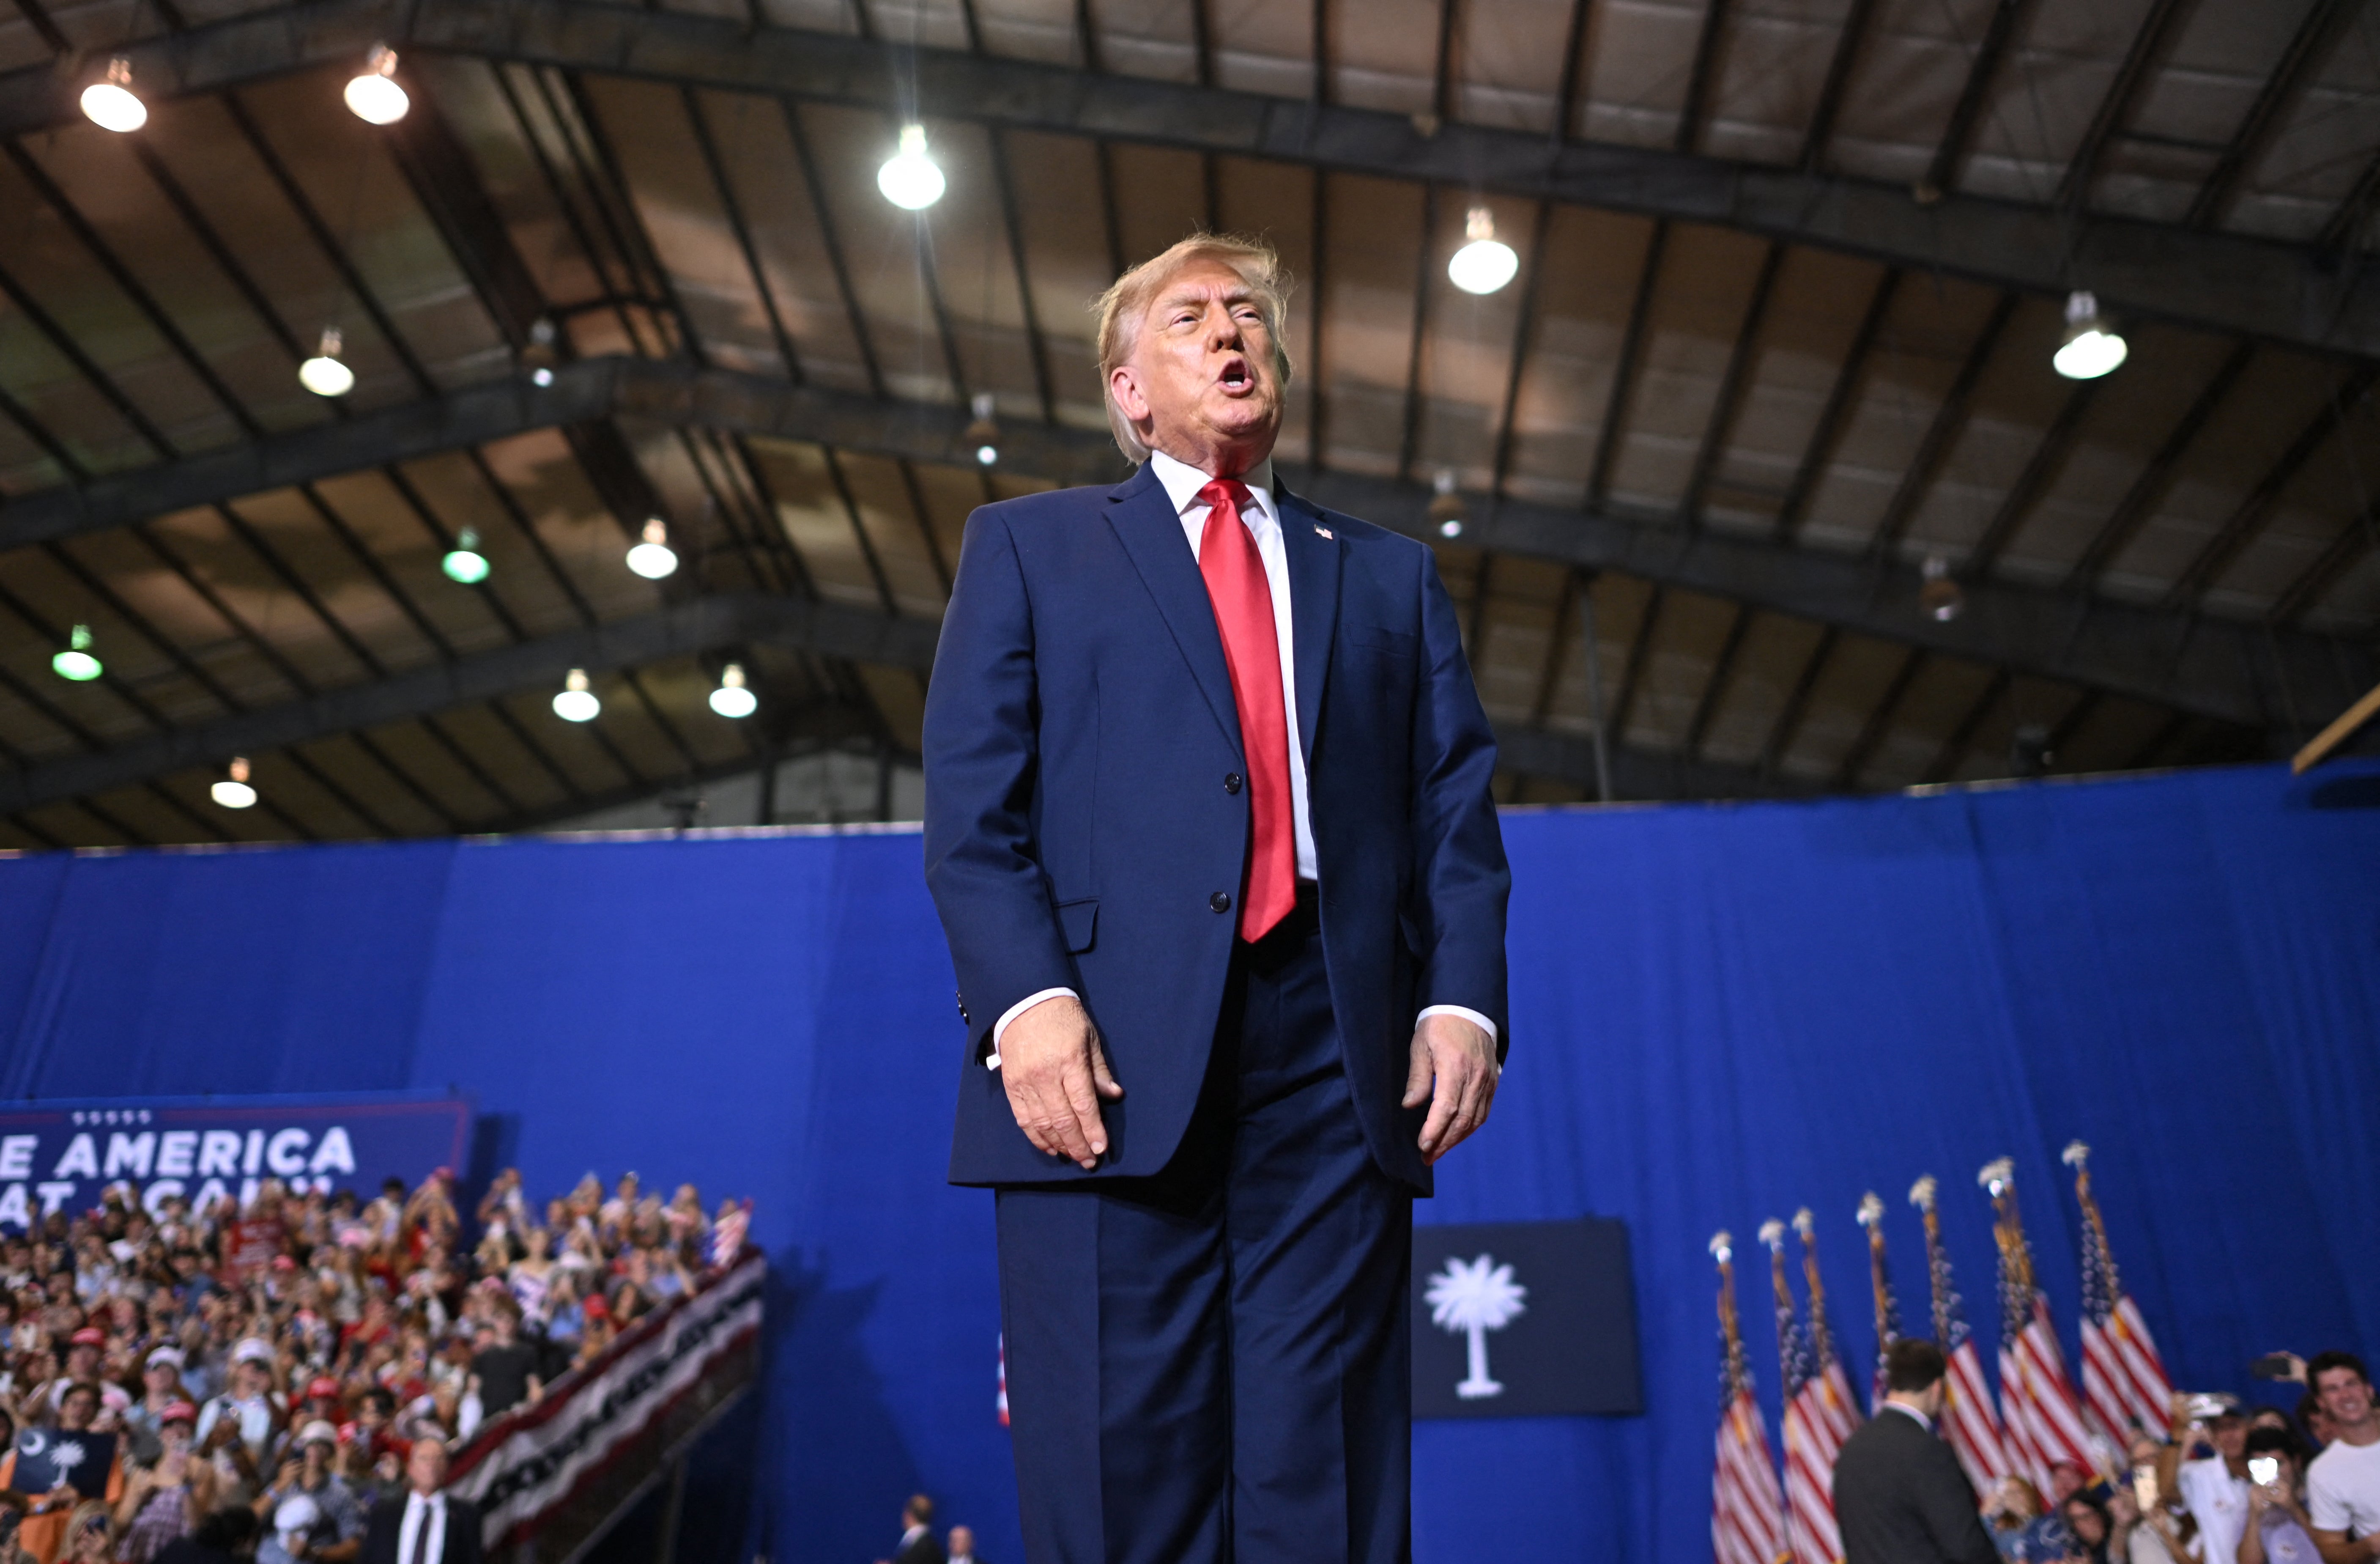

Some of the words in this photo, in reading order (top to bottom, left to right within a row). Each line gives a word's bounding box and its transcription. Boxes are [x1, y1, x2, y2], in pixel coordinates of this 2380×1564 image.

[0, 1134, 39, 1180] E
[52, 1126, 356, 1179] AMERICA
[0, 1181, 77, 1228] AT
